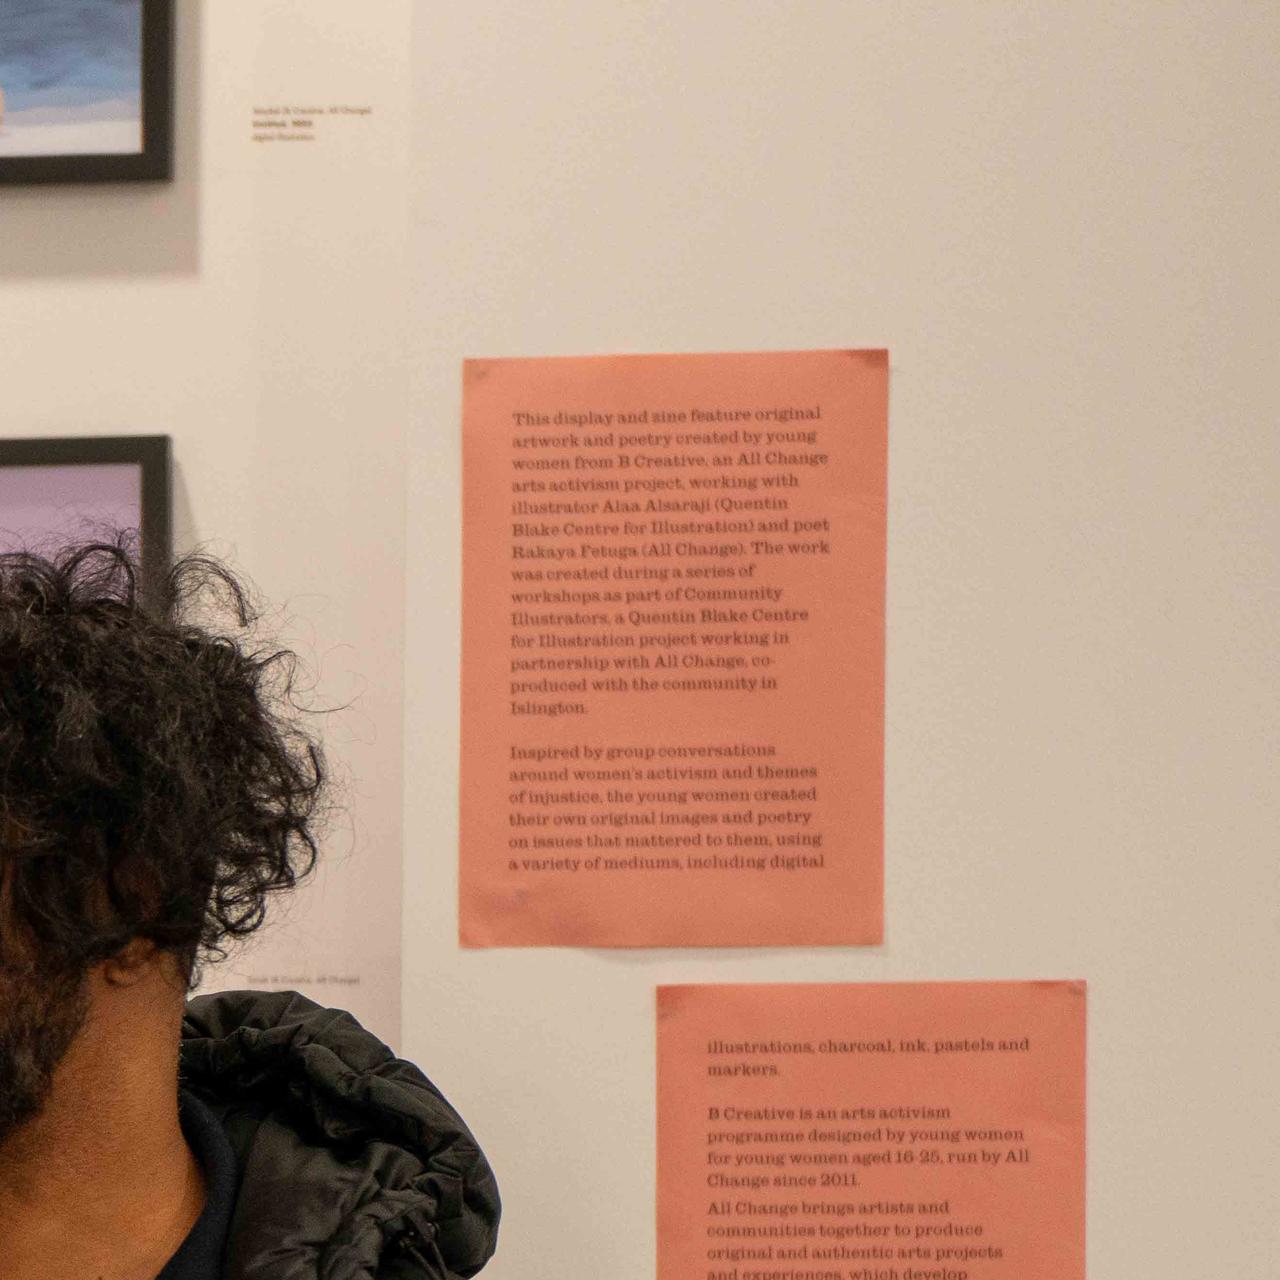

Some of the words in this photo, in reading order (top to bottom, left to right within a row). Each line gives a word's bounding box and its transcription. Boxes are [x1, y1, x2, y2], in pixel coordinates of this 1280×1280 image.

[553, 409, 612, 427] display
[690, 407, 751, 422] feature
[755, 405, 820, 424] original
[512, 433, 578, 448] artwork
[619, 432, 671, 449] poetry
[767, 432, 817, 446] young
[549, 477, 619, 491] activism
[512, 499, 598, 514] illustrator
[715, 495, 788, 513] (Quentin
[512, 521, 559, 536] Blake
[563, 520, 619, 535] Centre
[613, 564, 668, 582] during
[511, 588, 600, 606] workshops
[684, 585, 782, 603] Community
[628, 608, 695, 626] Quentin
[701, 607, 748, 622] Blake
[752, 606, 808, 621] Centre
[539, 632, 634, 647] Illustration
[510, 655, 609, 673] partnership
[510, 677, 587, 695] produced
[662, 676, 757, 693] community
[510, 744, 580, 762] Inspired
[658, 743, 776, 757] conversations
[509, 767, 568, 781] around
[574, 766, 642, 781] women's
[647, 766, 717, 780] activism
[757, 763, 817, 778] themes
[638, 791, 687, 805] young
[591, 810, 655, 828] original
[660, 811, 718, 827] images
[758, 810, 811, 826] poetry
[625, 832, 701, 847] mattered
[687, 854, 766, 872] including
[770, 854, 824, 871] digital
[934, 1037, 994, 1054] pastels
[998, 1036, 1030, 1051] and
[723, 1105, 794, 1119] Creative
[841, 1106, 875, 1119] arts
[879, 1106, 950, 1119] activism
[707, 1132, 804, 1146] programme
[808, 1127, 881, 1145] designed
[910, 1130, 961, 1144] young
[965, 1129, 1024, 1140] women
[707, 1151, 730, 1165] for
[736, 1154, 785, 1168] young
[790, 1153, 847, 1164] women
[852, 1149, 892, 1167] aged
[948, 1152, 977, 1163] run
[1006, 1148, 1030, 1162] All
[707, 1172, 769, 1190] Change
[773, 1173, 816, 1186] since
[708, 1200, 731, 1214] All
[735, 1200, 798, 1217] Change
[802, 1200, 854, 1217] brings
[858, 1201, 914, 1214] artists
[918, 1200, 949, 1214] and
[707, 1224, 815, 1237] communities
[819, 1222, 889, 1239] together
[915, 1221, 983, 1239] produce
[707, 1245, 772, 1262] original
[777, 1245, 807, 1259] and
[812, 1245, 893, 1259] authentic
[897, 1246, 930, 1259] arts
[936, 1245, 1003, 1262] projects
[850, 1267, 898, 1280] which
